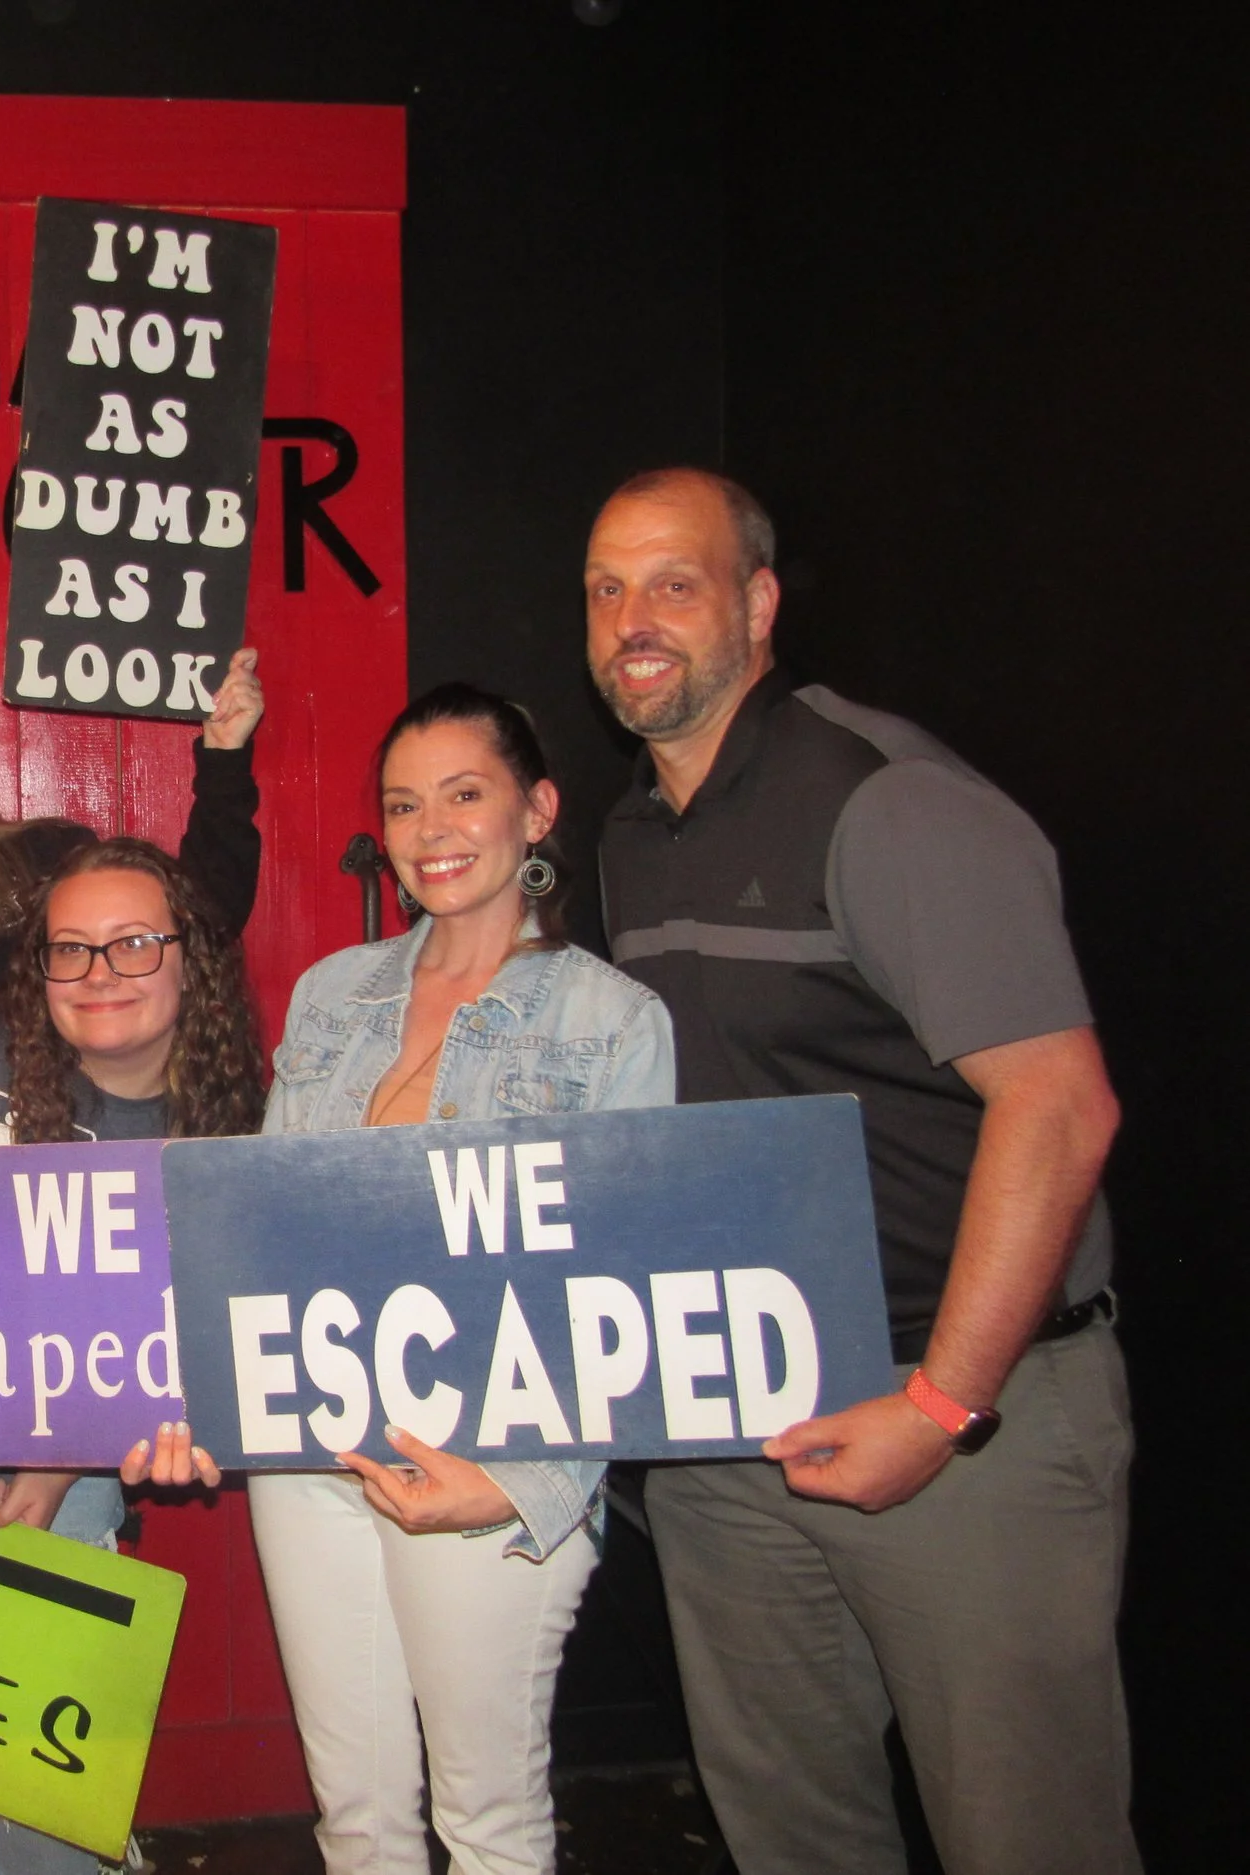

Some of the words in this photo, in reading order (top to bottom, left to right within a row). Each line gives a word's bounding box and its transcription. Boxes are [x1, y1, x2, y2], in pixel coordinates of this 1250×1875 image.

[87, 222, 212, 293] I'M
[67, 305, 223, 379] NOT
[85, 394, 188, 458] AS
[15, 470, 246, 548] DUMB
[45, 559, 150, 622] AS
[176, 571, 206, 628] I
[16, 639, 217, 713] LOOK
[13, 1171, 140, 1274] WE
[427, 1141, 574, 1257] WE
[229, 1267, 820, 1454] ESCAPED
